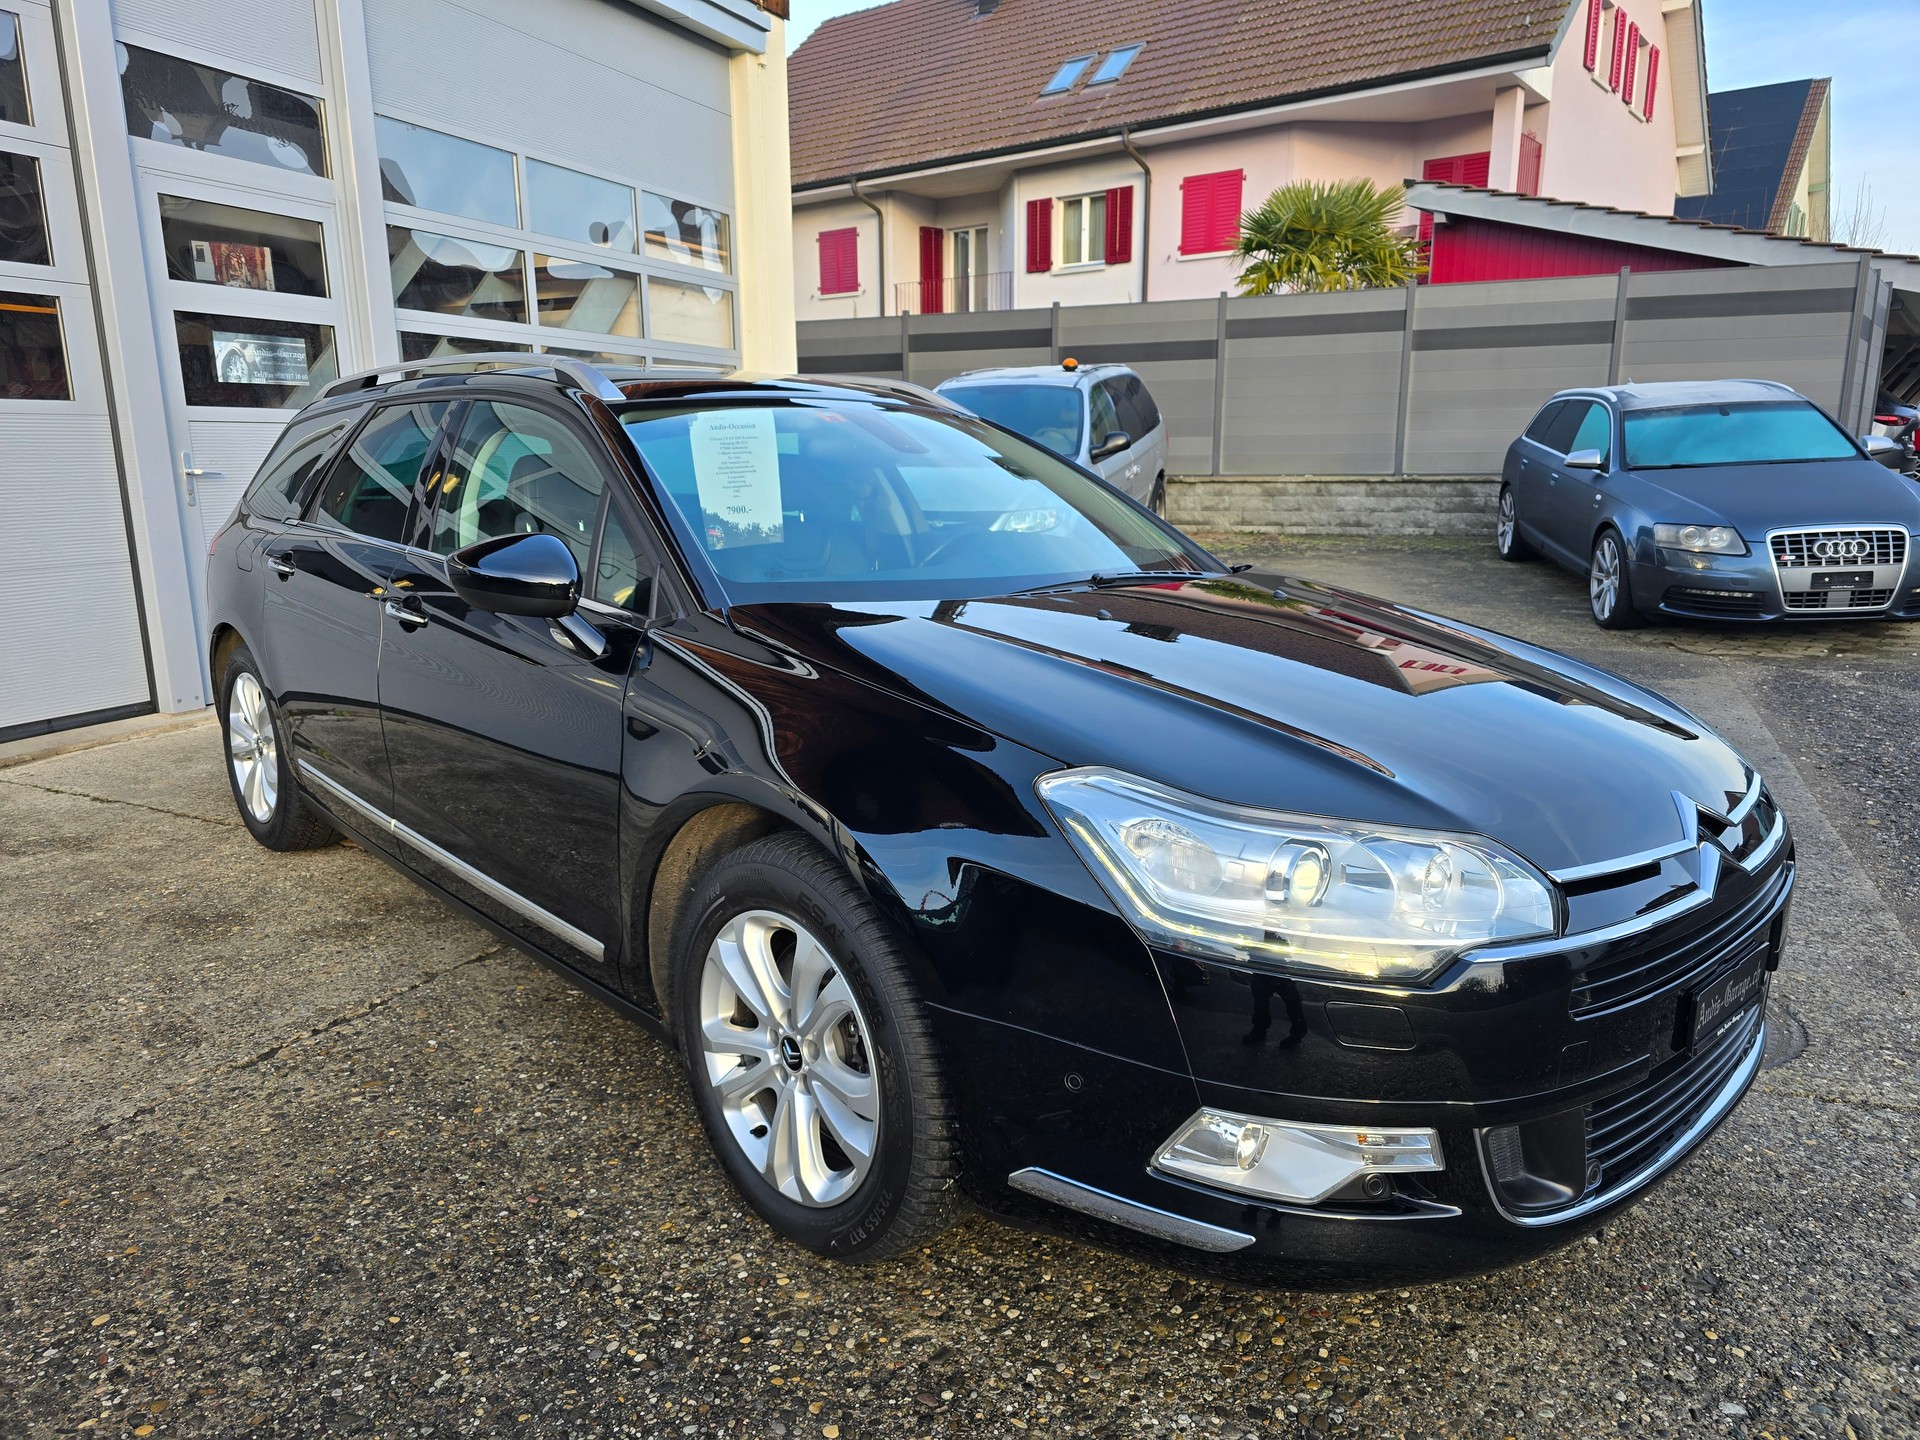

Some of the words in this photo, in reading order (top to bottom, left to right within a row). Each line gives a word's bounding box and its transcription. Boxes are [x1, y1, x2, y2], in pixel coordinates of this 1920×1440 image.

[709, 422, 757, 431] Andis-Occasion
[726, 505, 752, 515] 7900.-
[705, 883, 720, 903] PRO
[865, 1187, 893, 1232] 225/55
[849, 1226, 867, 1246] R17
